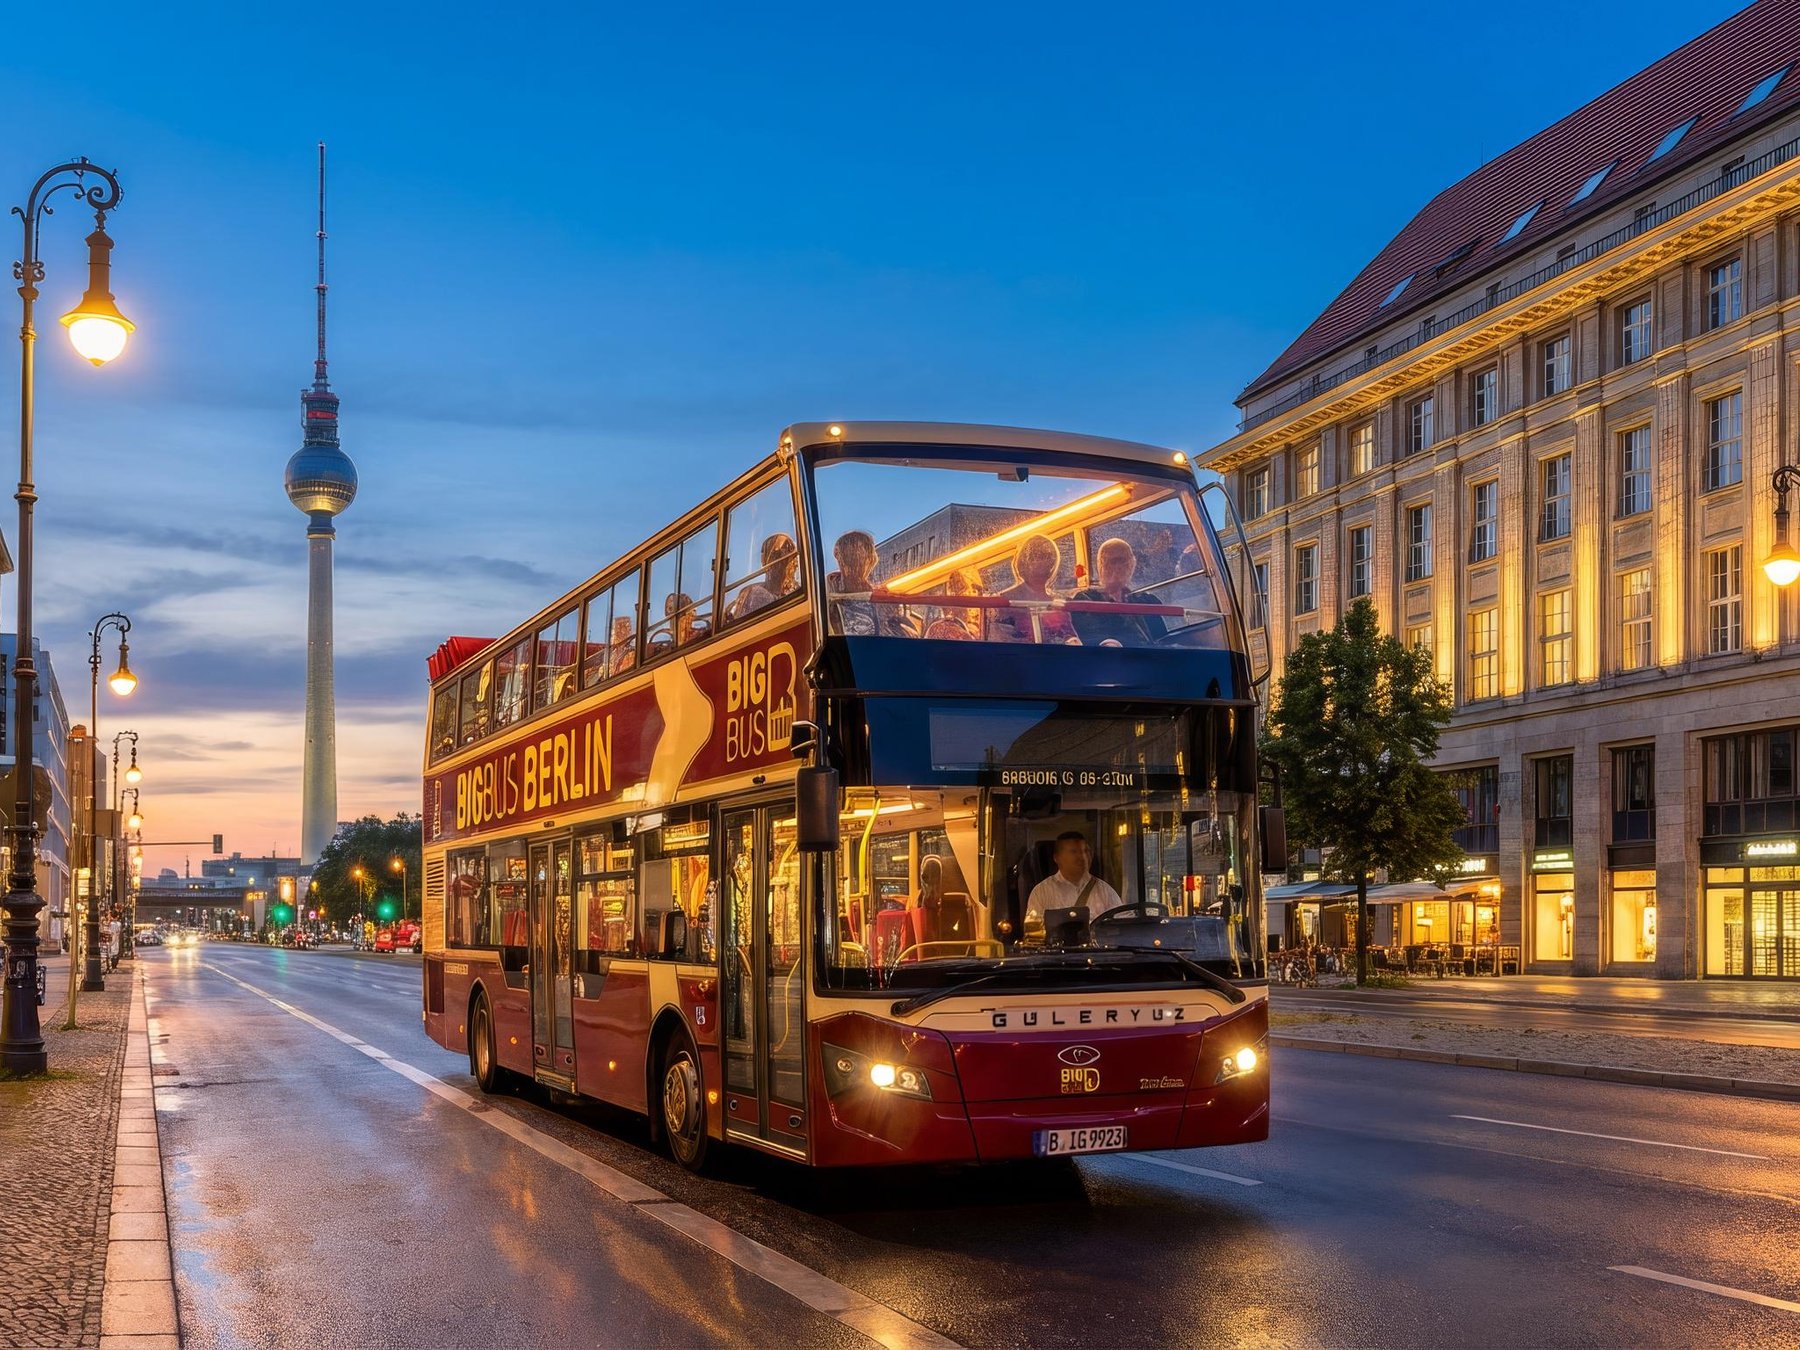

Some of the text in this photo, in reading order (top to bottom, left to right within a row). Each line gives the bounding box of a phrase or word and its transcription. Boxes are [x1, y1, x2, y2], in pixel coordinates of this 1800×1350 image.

[726, 651, 766, 713] BIG
[523, 714, 613, 812] BERLIN
[726, 709, 765, 763] BUS
[1049, 1132, 1059, 1152] B
